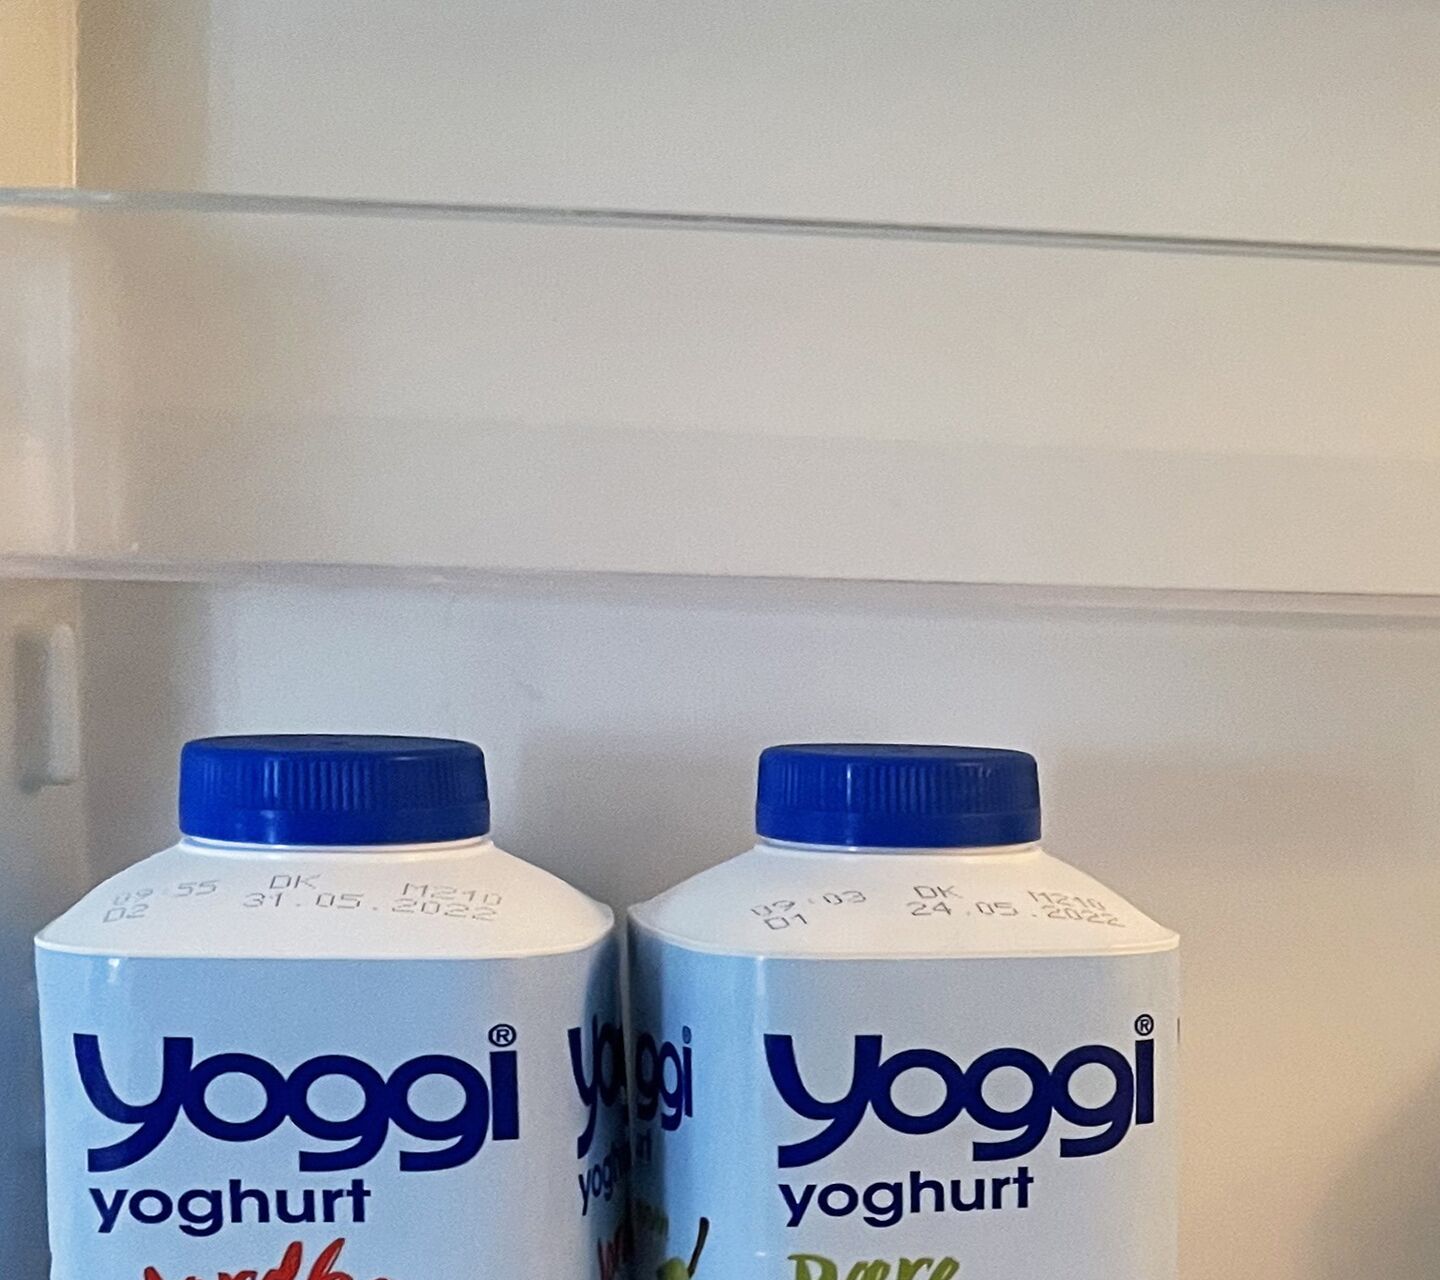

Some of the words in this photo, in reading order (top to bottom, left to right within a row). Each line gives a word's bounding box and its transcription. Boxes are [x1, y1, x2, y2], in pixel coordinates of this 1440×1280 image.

[269, 873, 321, 890] DK
[913, 885, 964, 901] DK
[89, 1179, 371, 1234] yoghurt
[778, 1166, 1035, 1228] yoghurt
